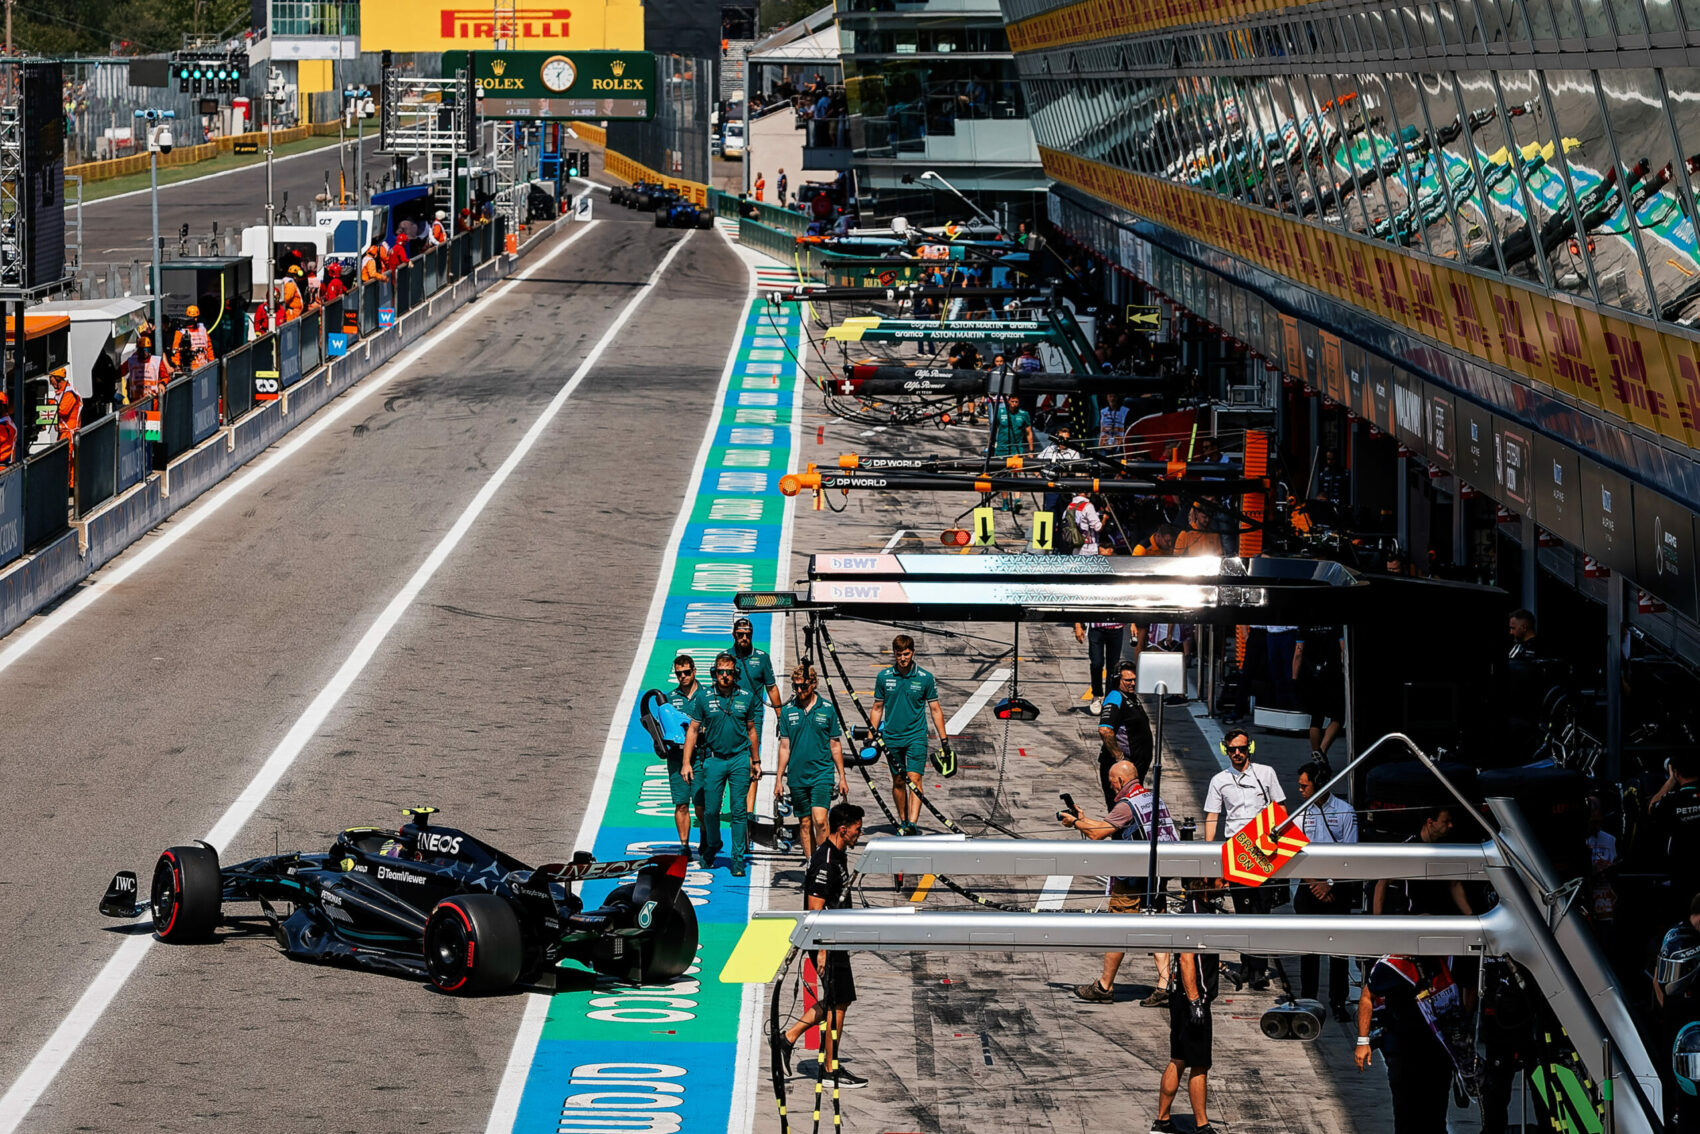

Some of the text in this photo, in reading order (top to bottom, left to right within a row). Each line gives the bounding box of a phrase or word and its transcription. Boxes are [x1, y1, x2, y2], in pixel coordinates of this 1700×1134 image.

[441, 9, 572, 38] PIRELLI
[475, 78, 525, 90] ROLEX
[592, 78, 644, 90] ROLEX
[381, 313, 391, 322] W
[950, 321, 974, 329] ASTON
[976, 321, 1004, 329] MARTIN
[1009, 321, 1038, 329] aramco
[990, 331, 1025, 339] cognizant
[332, 339, 344, 349] W
[914, 369, 953, 379] Alfa Romeo
[904, 381, 946, 391] Alfa Romeo
[873, 459, 922, 468] DP WORLD
[836, 478, 887, 486] DP WORLD
[843, 558, 878, 568] BWT
[844, 586, 880, 598] BWT
[417, 831, 464, 855] INEOS
[1235, 831, 1274, 873] BRAKES
[1237, 853, 1255, 871] ON
[555, 859, 649, 880] INEOS
[385, 868, 427, 885] TeamViewer
[115, 875, 136, 893] IWC
